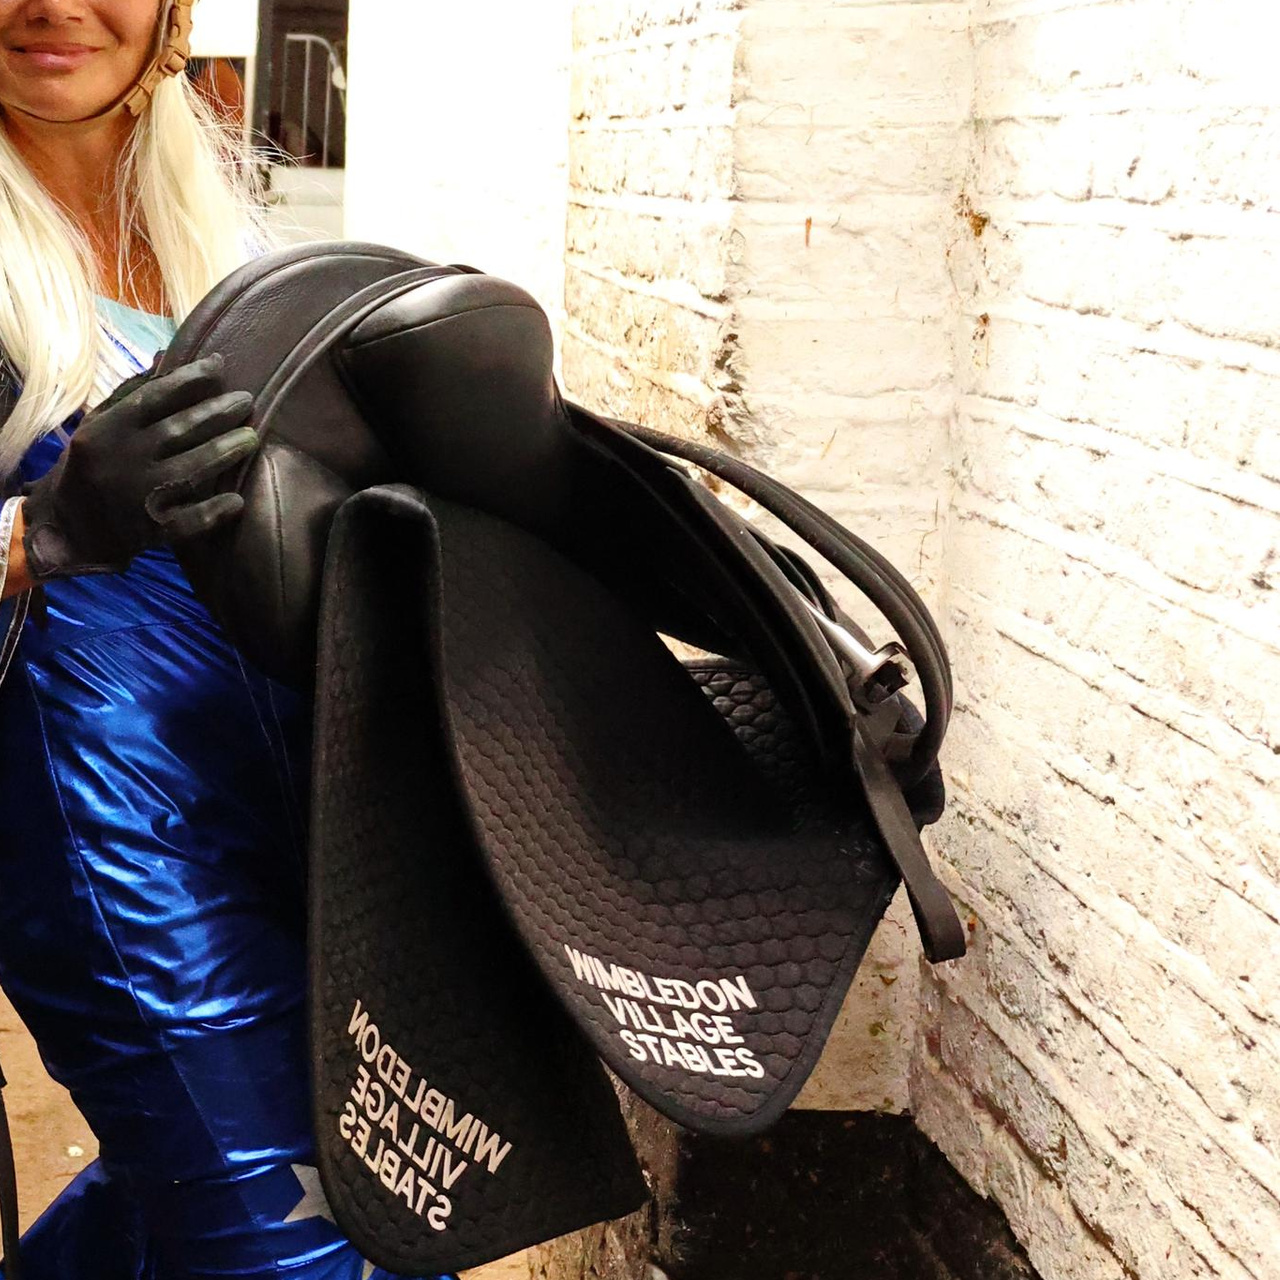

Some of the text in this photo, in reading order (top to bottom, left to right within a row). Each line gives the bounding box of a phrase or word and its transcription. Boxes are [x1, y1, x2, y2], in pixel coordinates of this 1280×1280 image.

[564, 943, 758, 1013] WIMBLEDON
[601, 992, 745, 1045] VILLAGE
[619, 1029, 765, 1079] STABLES
